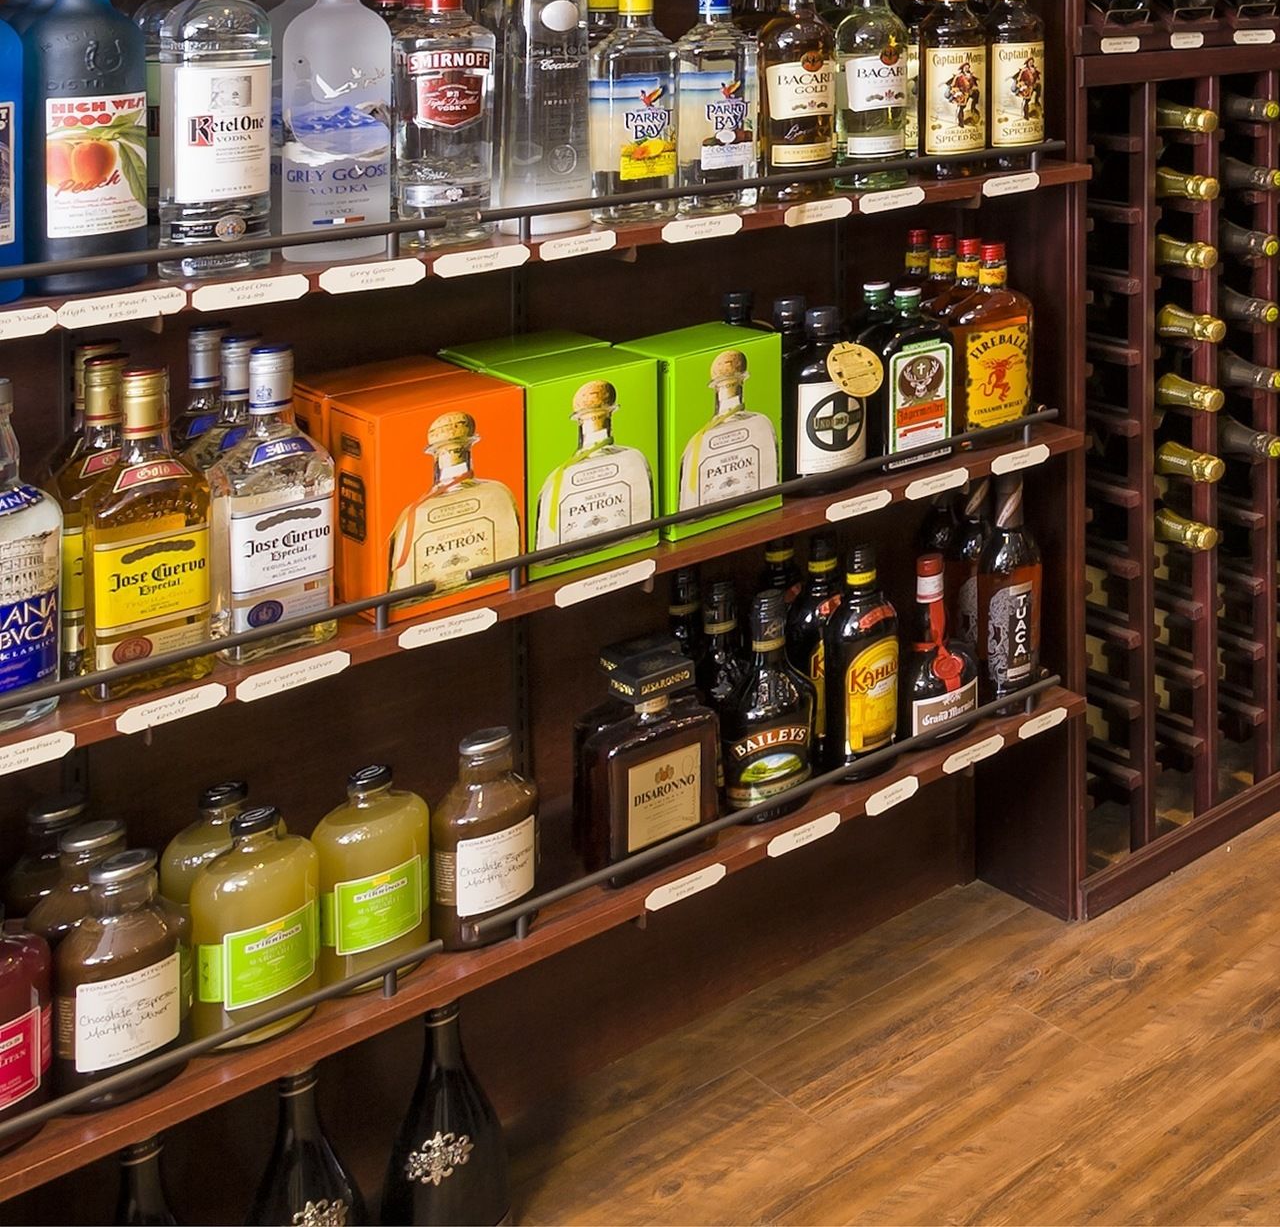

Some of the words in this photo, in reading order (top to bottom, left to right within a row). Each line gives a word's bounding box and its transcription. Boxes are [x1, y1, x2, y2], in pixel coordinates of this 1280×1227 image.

[409, 49, 489, 72] SMIRNOFF
[932, 52, 964, 65] Captain
[856, 66, 906, 79] BACAR
[793, 83, 828, 94] GOLD
[51, 100, 106, 115] HIGH
[624, 107, 674, 126] PARROT
[706, 102, 749, 121] PARROT
[187, 115, 240, 147] Ketel
[240, 115, 264, 132] One
[215, 133, 252, 144] VODKA
[633, 123, 666, 141] BAY
[54, 169, 122, 197] Peach
[331, 162, 388, 181] GOOSE
[969, 333, 1027, 360] FIREBALL
[706, 456, 755, 479] PATRÓN
[0, 491, 31, 509] ANA
[568, 494, 624, 518] PATRÓN
[244, 537, 279, 558] Jose
[281, 524, 331, 548] Cuervo
[424, 531, 487, 557] PATRÓN
[270, 544, 308, 562] Especial
[110, 571, 148, 593] Jose
[151, 557, 207, 581] Cuervo
[139, 577, 181, 597] Especial
[2, 594, 57, 632] ANA
[0, 619, 55, 651] BVCA
[1014, 593, 1028, 657] TUACA
[921, 710, 950, 725] Grand
[734, 726, 807, 757] BAILEYS
[633, 773, 696, 808] DISARONNO
[459, 859, 502, 878] Chocolate
[463, 870, 503, 890] Martini
[504, 858, 529, 878] Mixer
[78, 975, 137, 995] STONEWALL
[78, 1007, 134, 1028] Chocolate
[136, 985, 179, 1012] Espresso
[84, 1021, 134, 1043] Martini
[134, 1002, 173, 1028] Mixer
